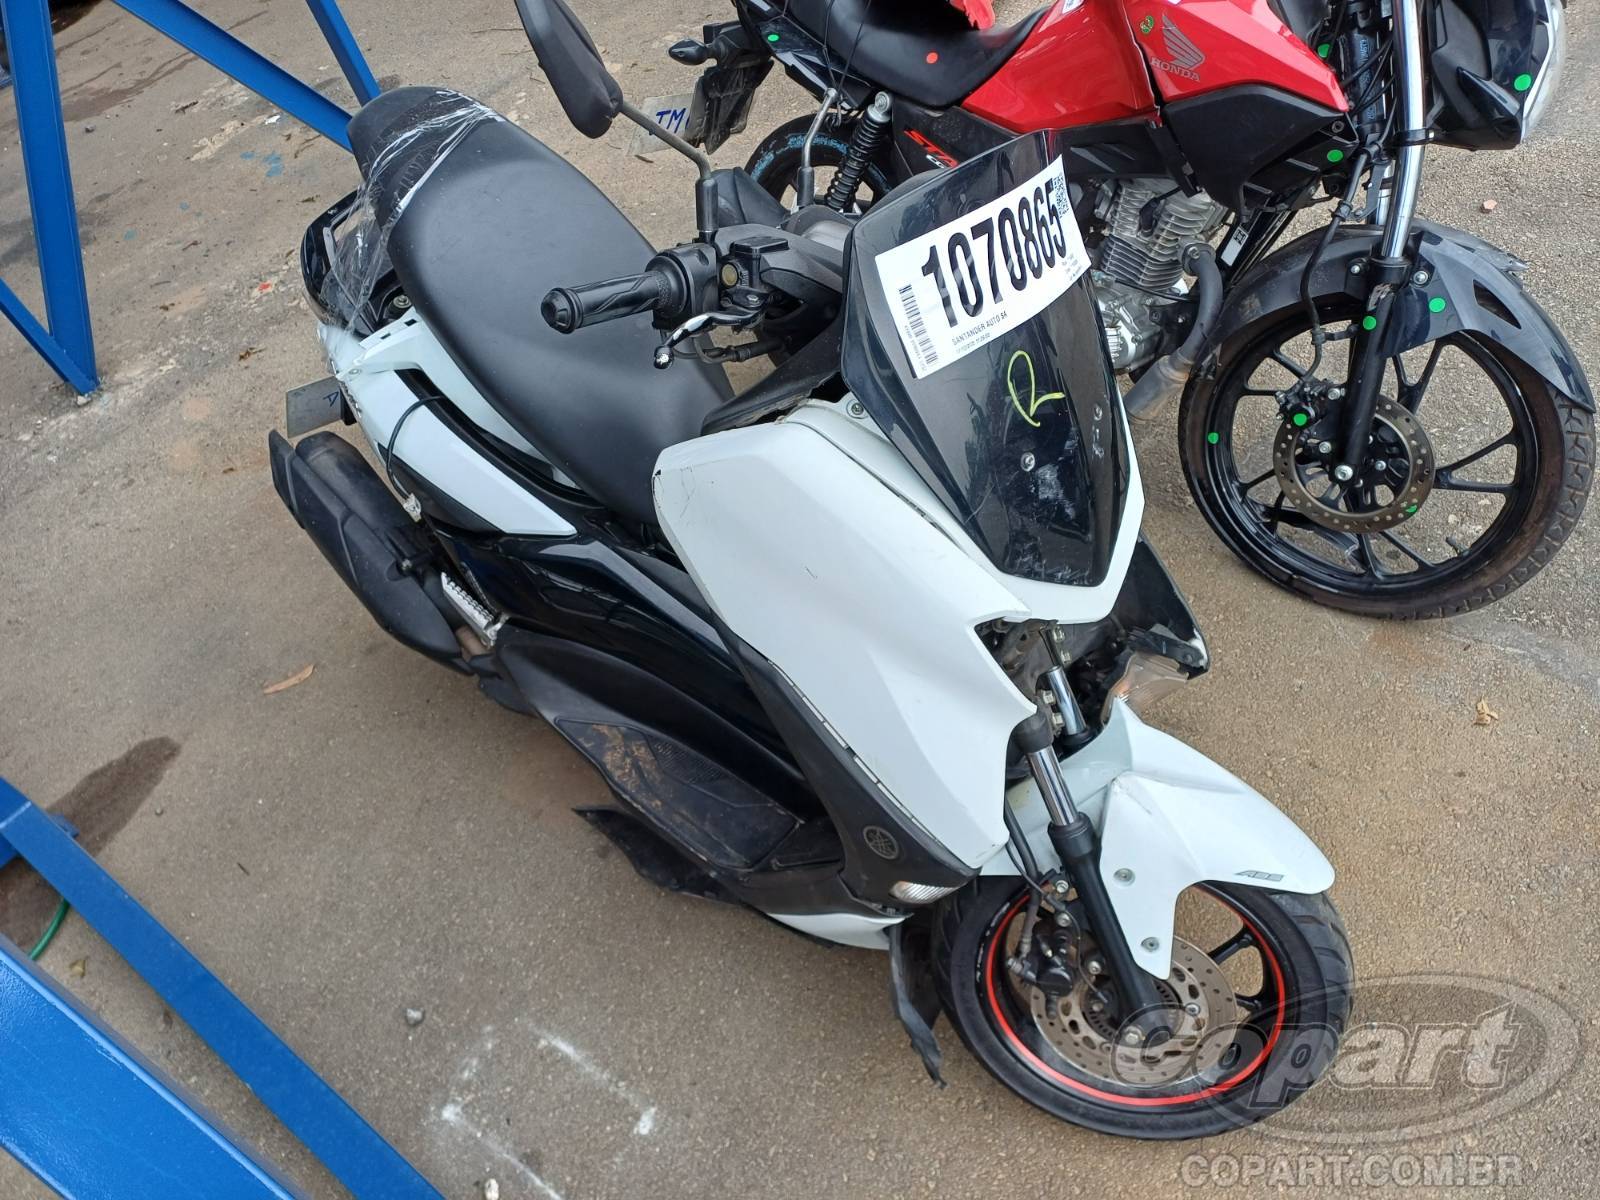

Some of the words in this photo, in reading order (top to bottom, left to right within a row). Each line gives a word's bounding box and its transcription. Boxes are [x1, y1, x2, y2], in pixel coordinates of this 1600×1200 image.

[1150, 57, 1201, 82] HONDA
[656, 108, 691, 134] TM
[921, 177, 1067, 328] 1070865
[951, 322, 987, 346] SANTANDER
[985, 313, 1002, 330] AUTO
